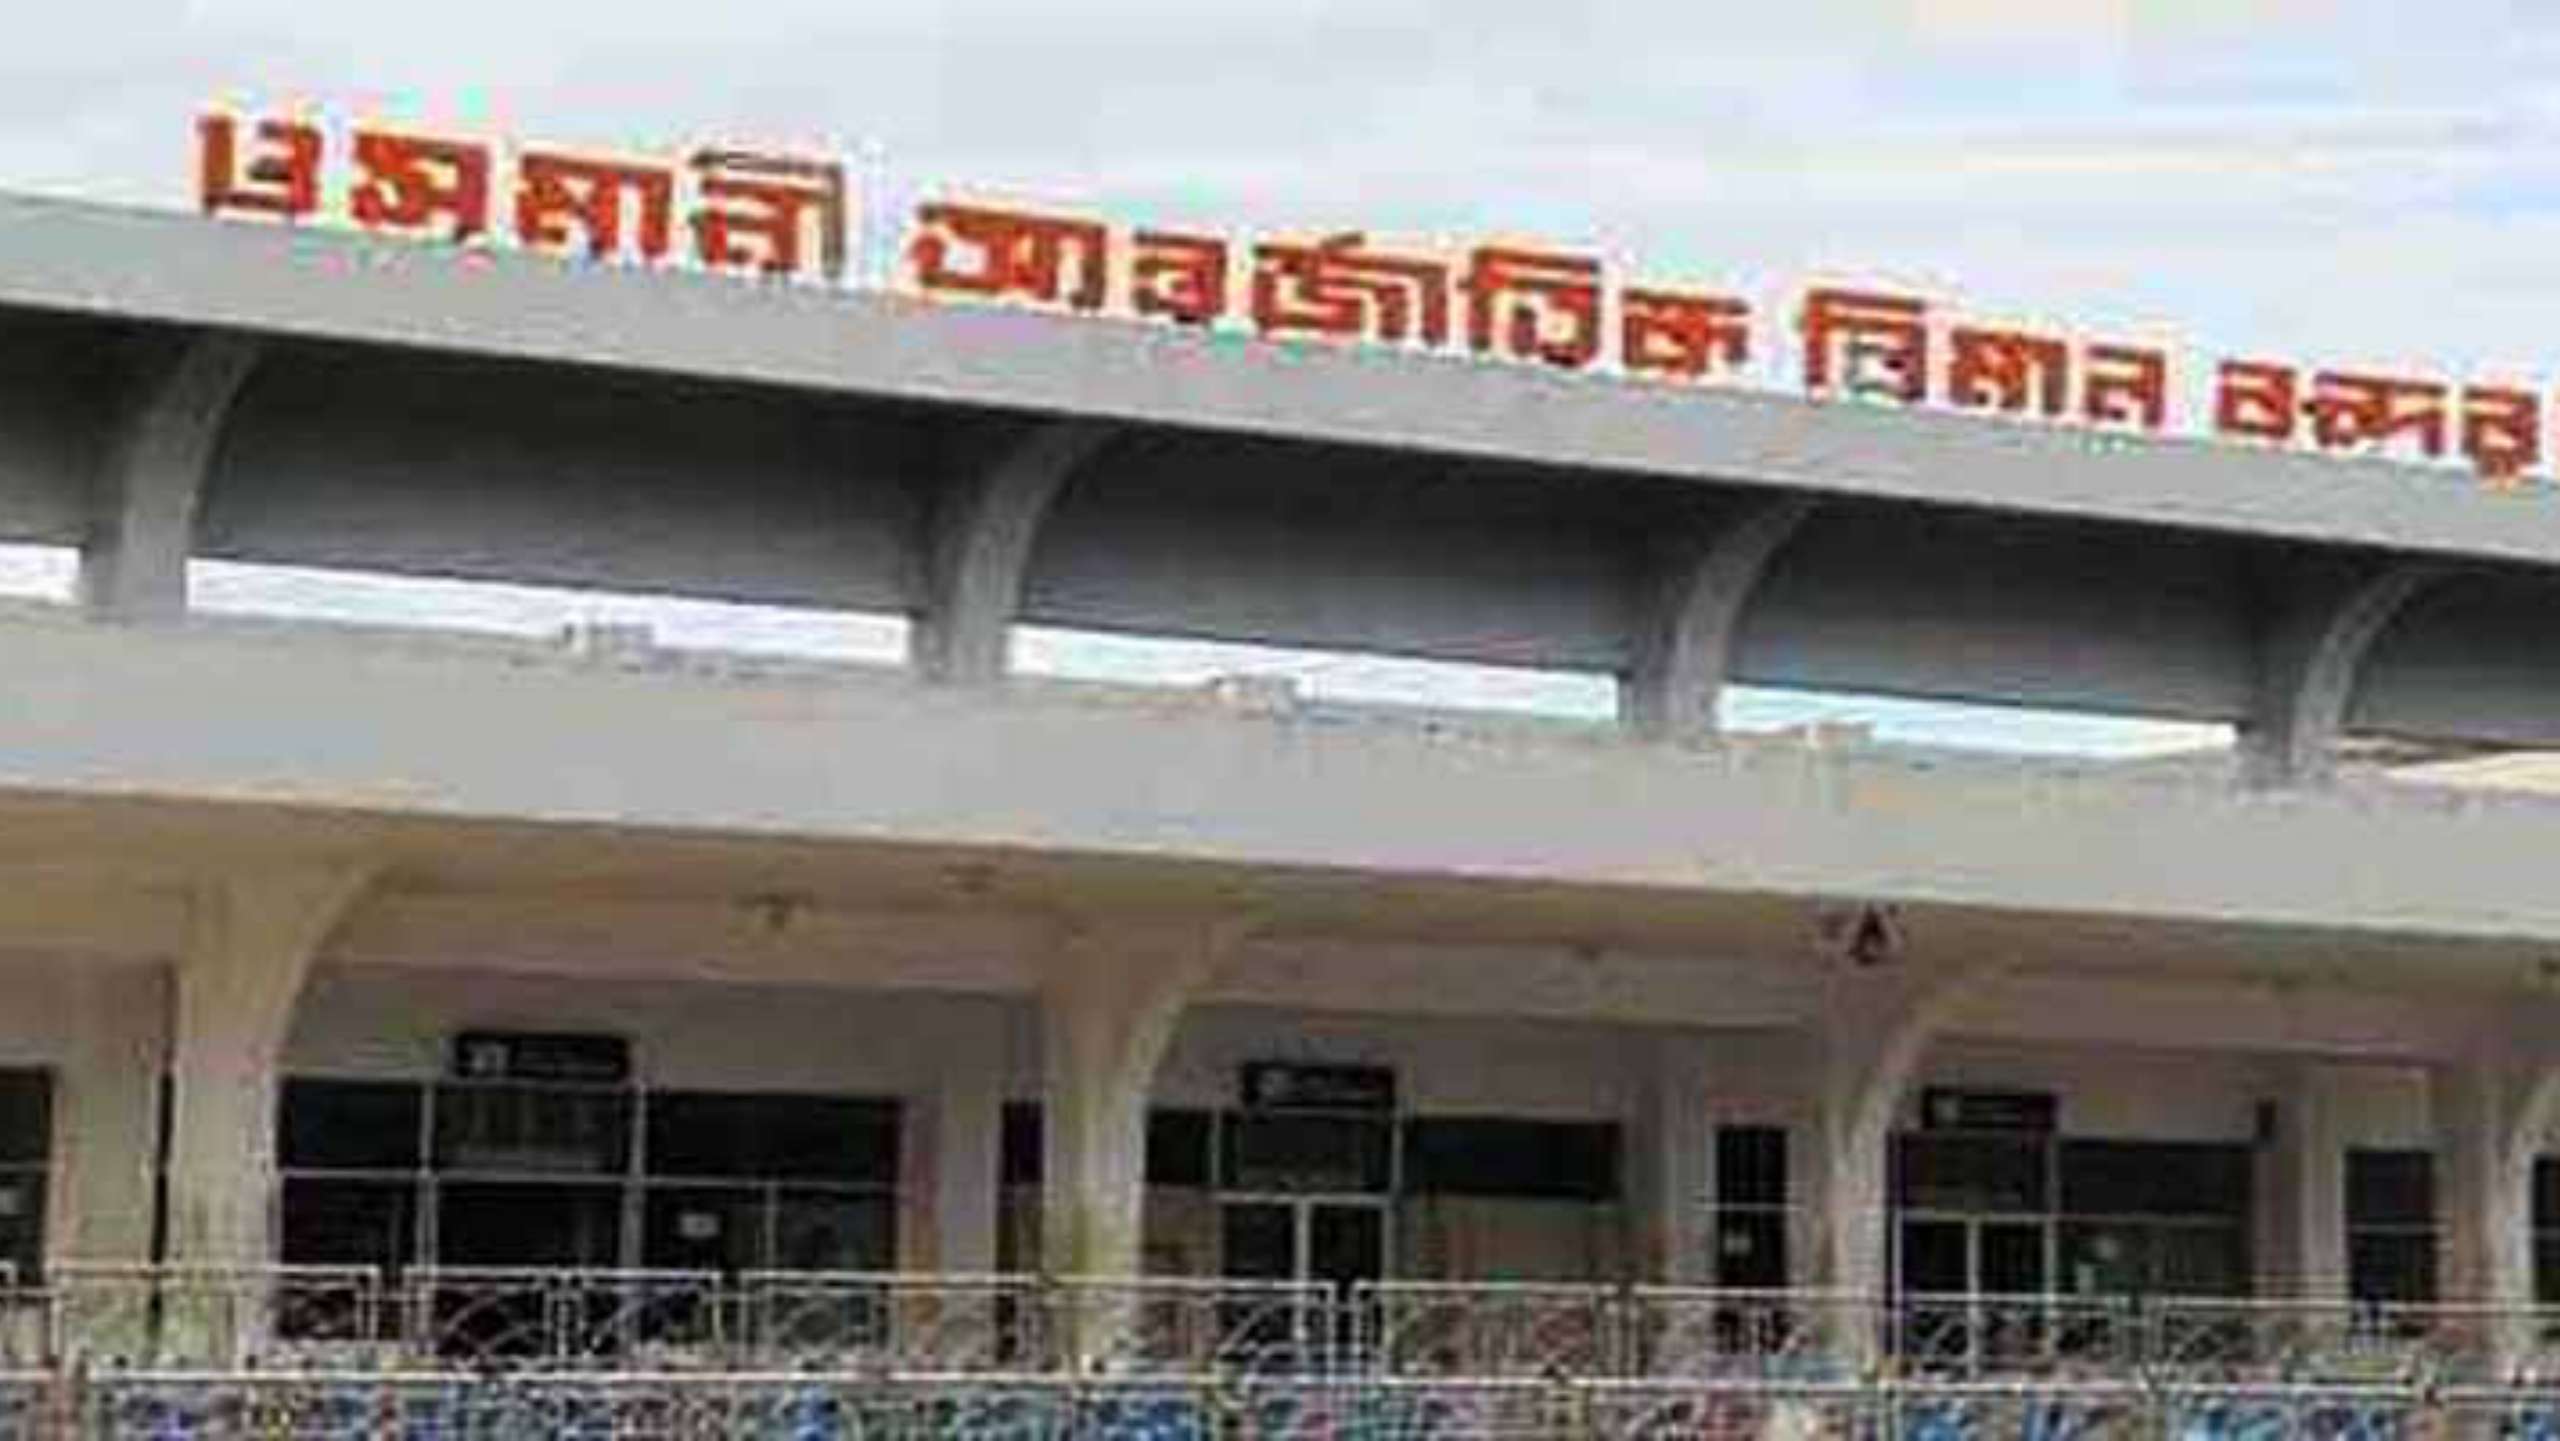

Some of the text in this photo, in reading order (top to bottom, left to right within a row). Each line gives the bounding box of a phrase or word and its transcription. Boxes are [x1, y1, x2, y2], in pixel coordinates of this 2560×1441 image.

[197, 113, 846, 278] ওসমানী
[1802, 288, 2166, 427] বিমান
[2216, 358, 2542, 480] বন্দর
